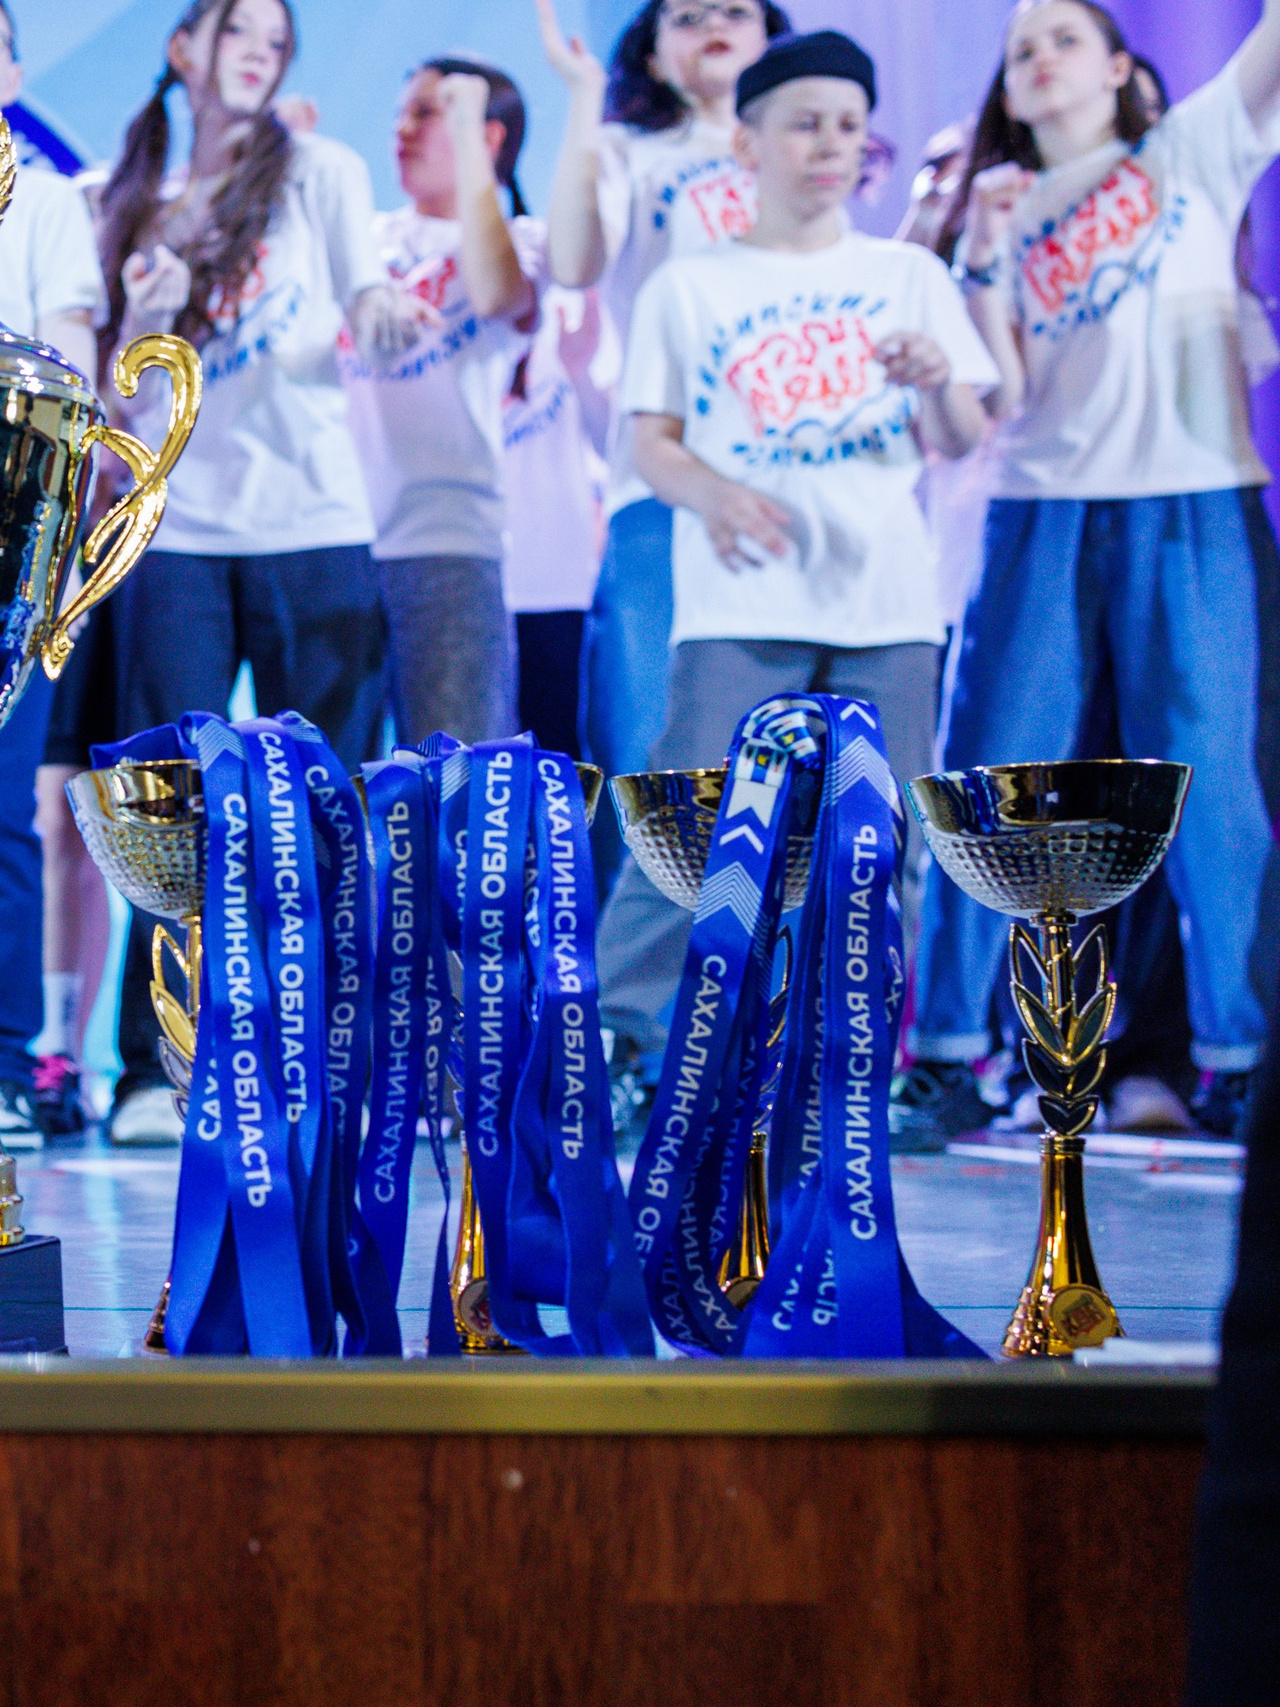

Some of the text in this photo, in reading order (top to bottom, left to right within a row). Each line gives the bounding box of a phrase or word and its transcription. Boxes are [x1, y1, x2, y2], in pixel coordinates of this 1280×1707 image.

[223, 792, 274, 1208] САХАЛИНСКАЯ ОБЛАСТЬ
[257, 731, 308, 1123] САХАЛИНСКАЯ ОБЛАСТЬ
[374, 801, 414, 1203] САХАЛИНСКАЯ ОБЛАСТЬ
[478, 751, 513, 1157] САХАЛИНСКАЯ ОБЛАСТЬ
[537, 758, 586, 1160] САХАЛИНСКАЯ ОБЛАСТЬ
[644, 955, 728, 1199] САХАЛИНСКАЯ
[844, 825, 878, 1241] САХАЛИНСКАЯ ОБЛАСТЬ
